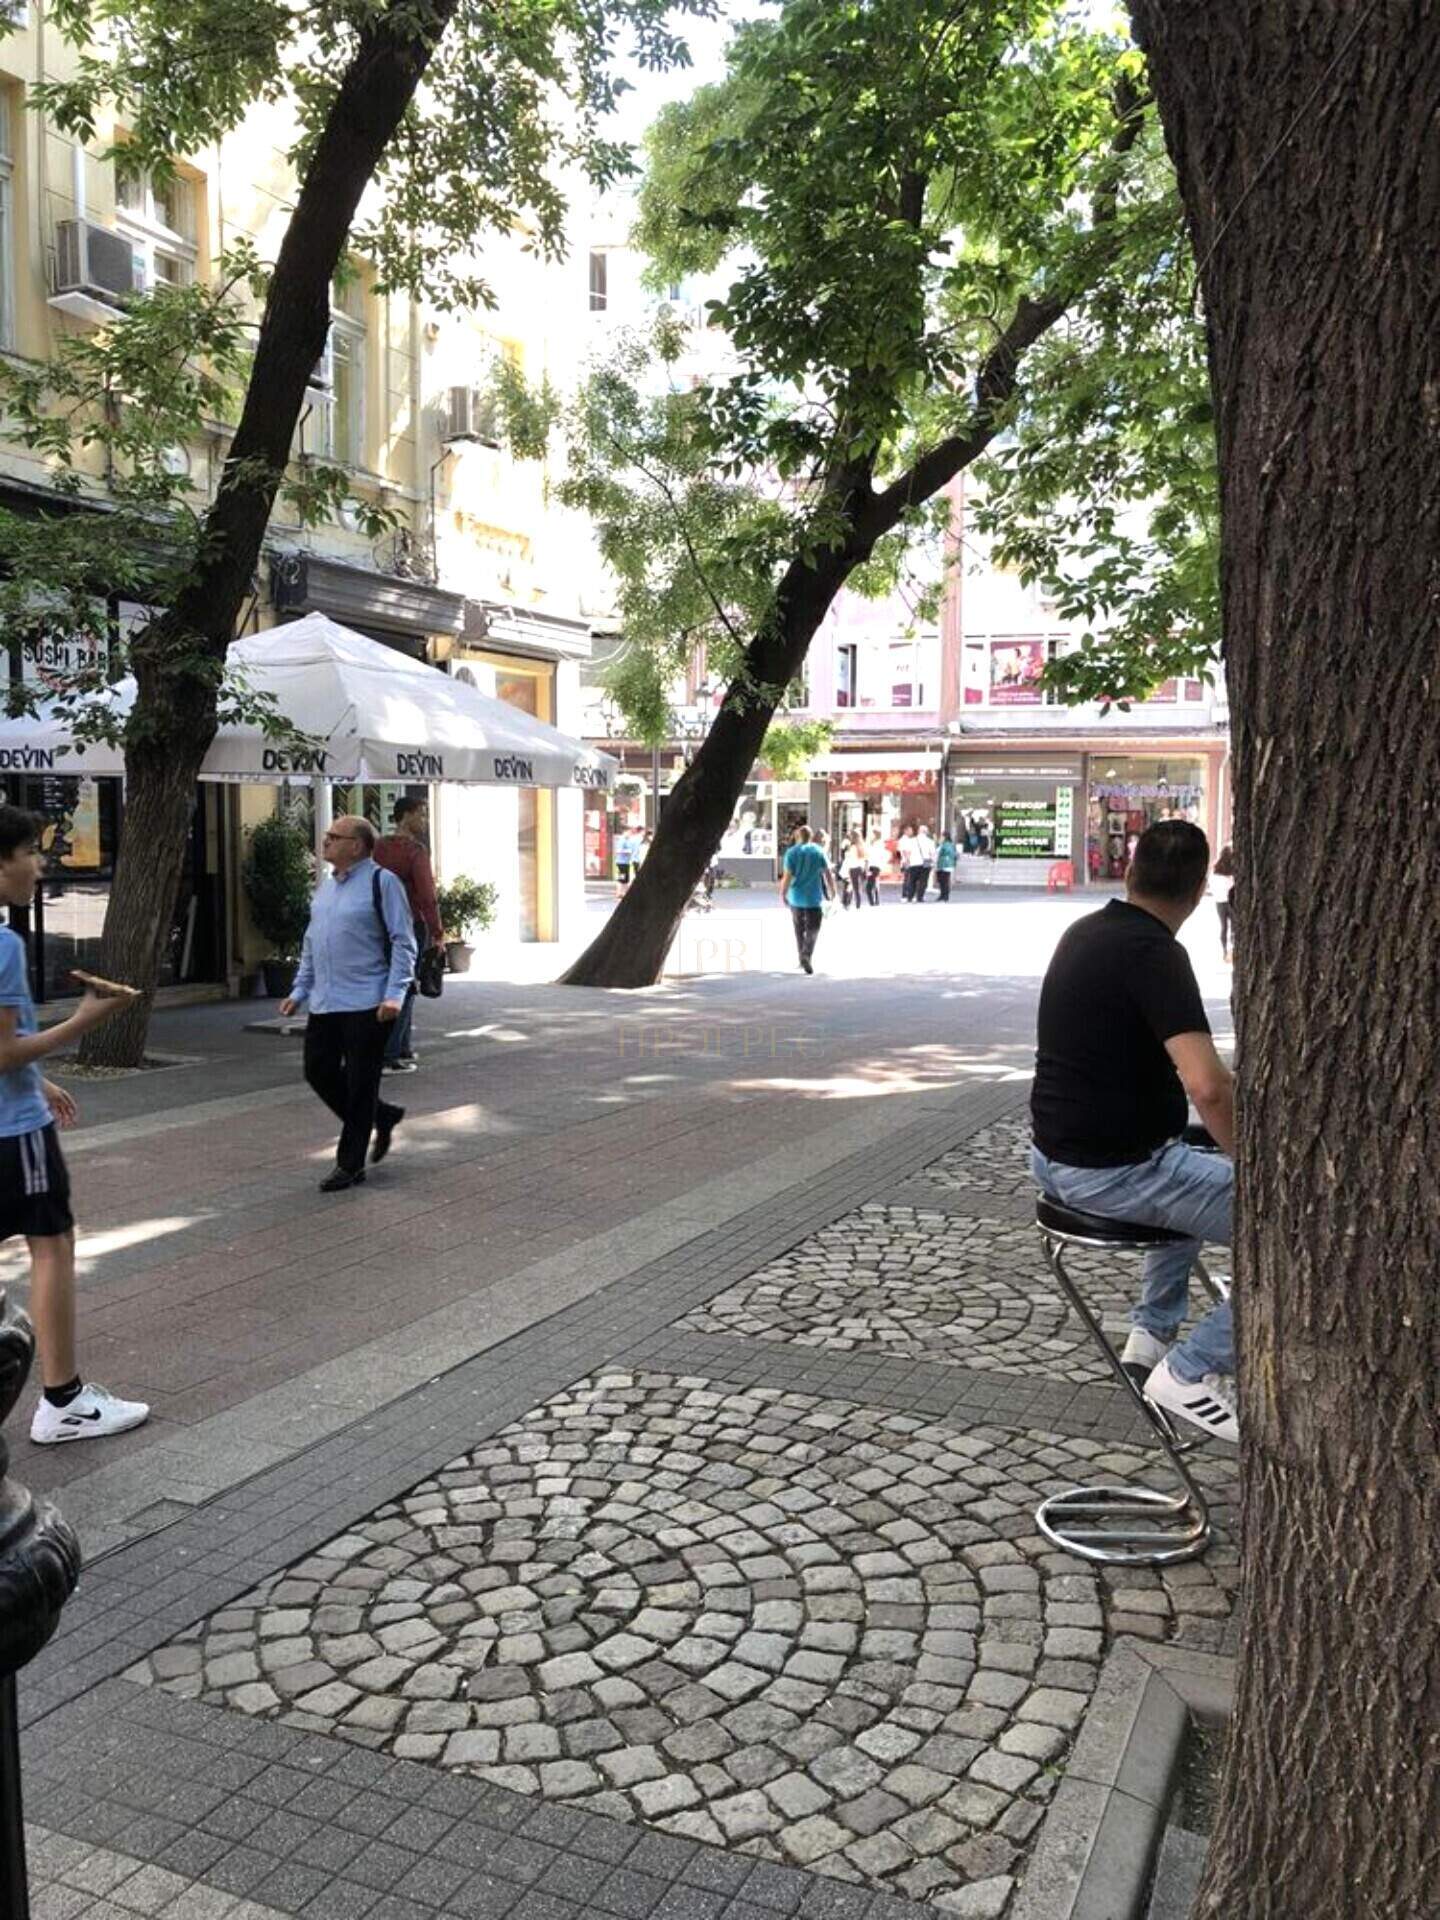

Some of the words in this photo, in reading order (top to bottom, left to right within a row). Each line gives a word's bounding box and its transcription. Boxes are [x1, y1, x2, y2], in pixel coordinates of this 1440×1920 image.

[23, 641, 70, 667] SUSHI
[0, 745, 53, 769] DEVIN
[262, 748, 326, 772] DEVIN
[397, 749, 443, 777] DEVIN
[494, 755, 533, 781] DEVIN
[573, 763, 608, 786] DEVIN
